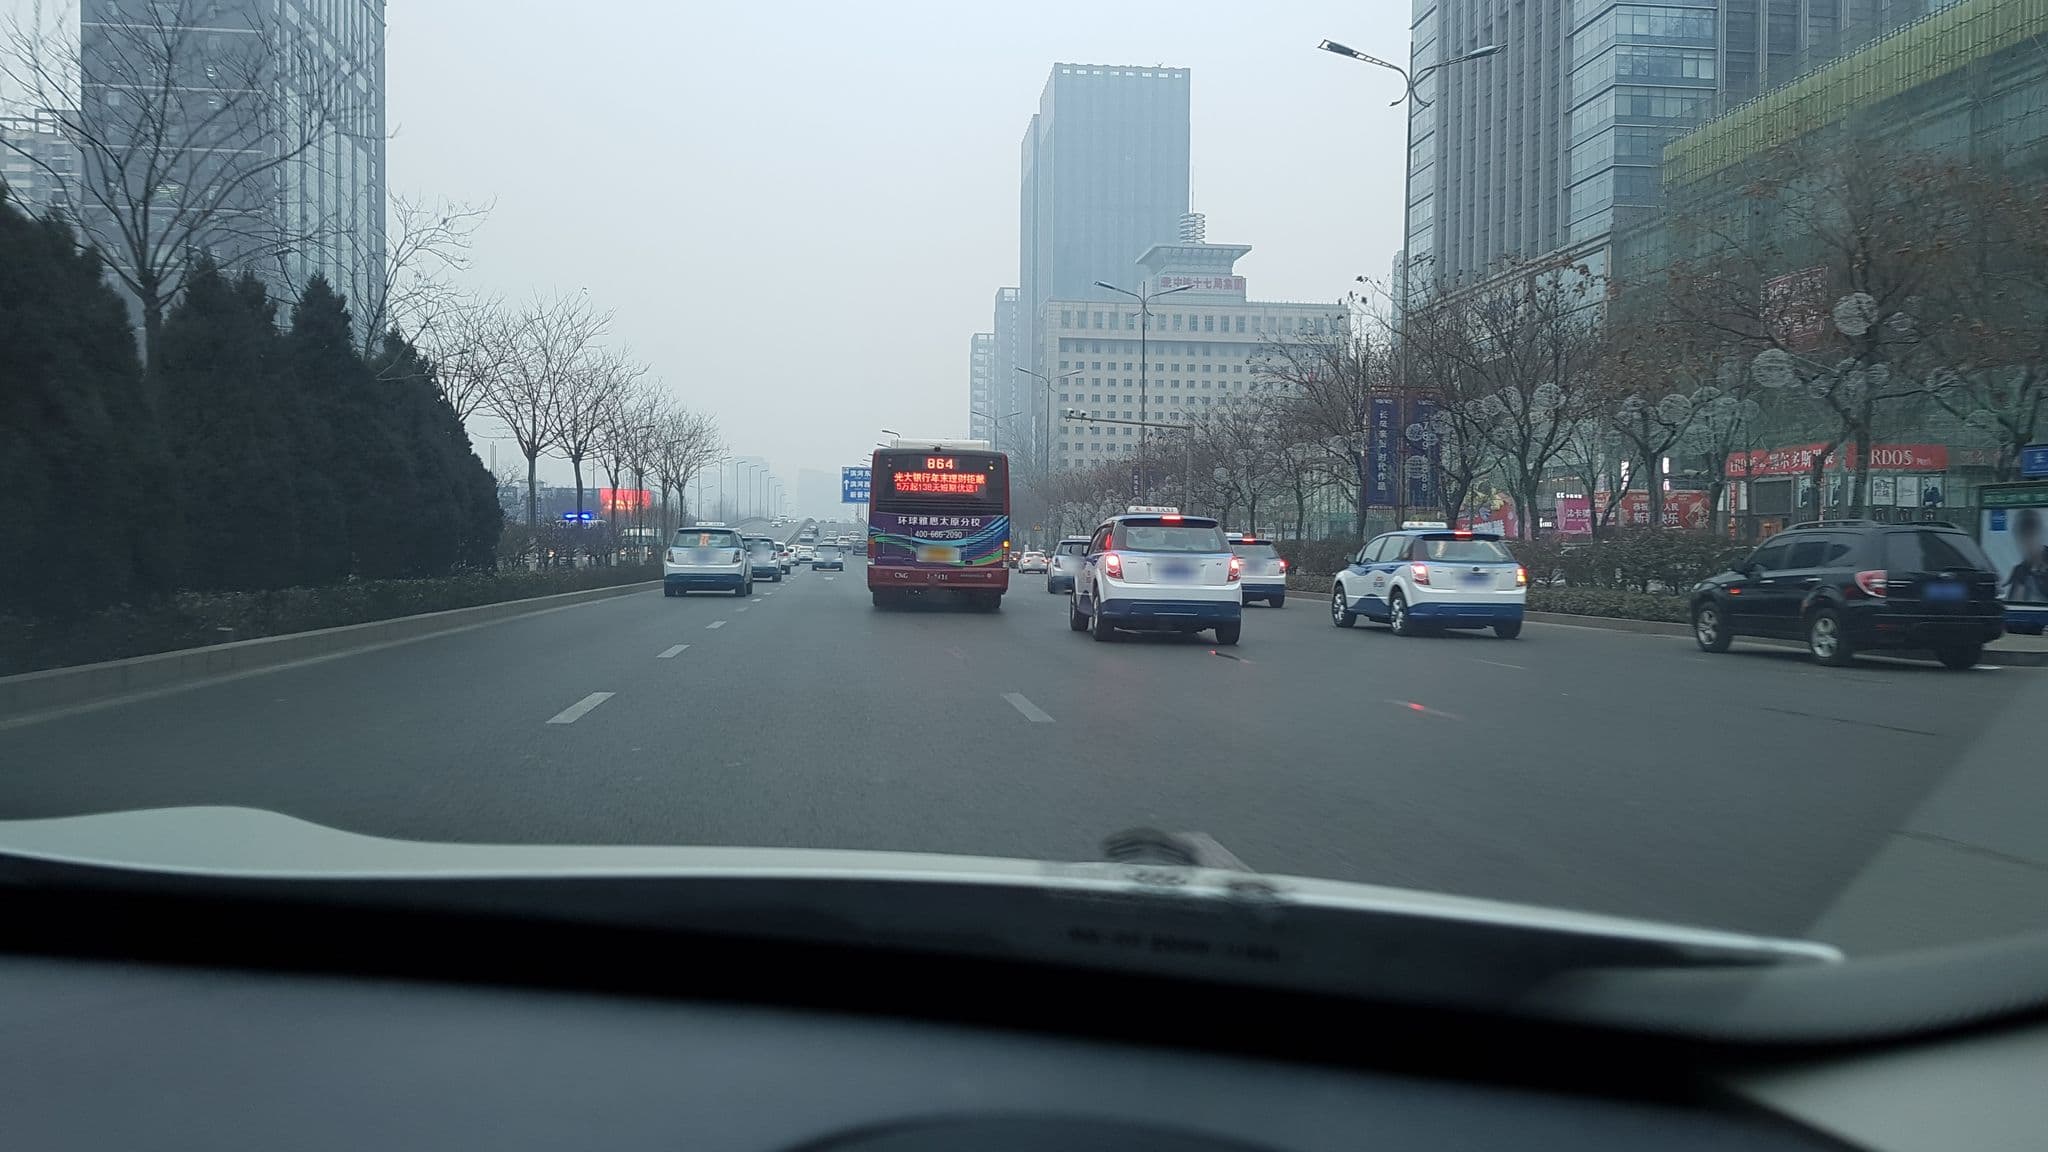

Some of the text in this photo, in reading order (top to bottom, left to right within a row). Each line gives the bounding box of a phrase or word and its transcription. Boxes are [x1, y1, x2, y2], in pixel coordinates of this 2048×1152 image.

[1871, 449, 1914, 466] RDOS
[927, 458, 953, 469] 864
[897, 516, 981, 526] 环球雅思太原分校
